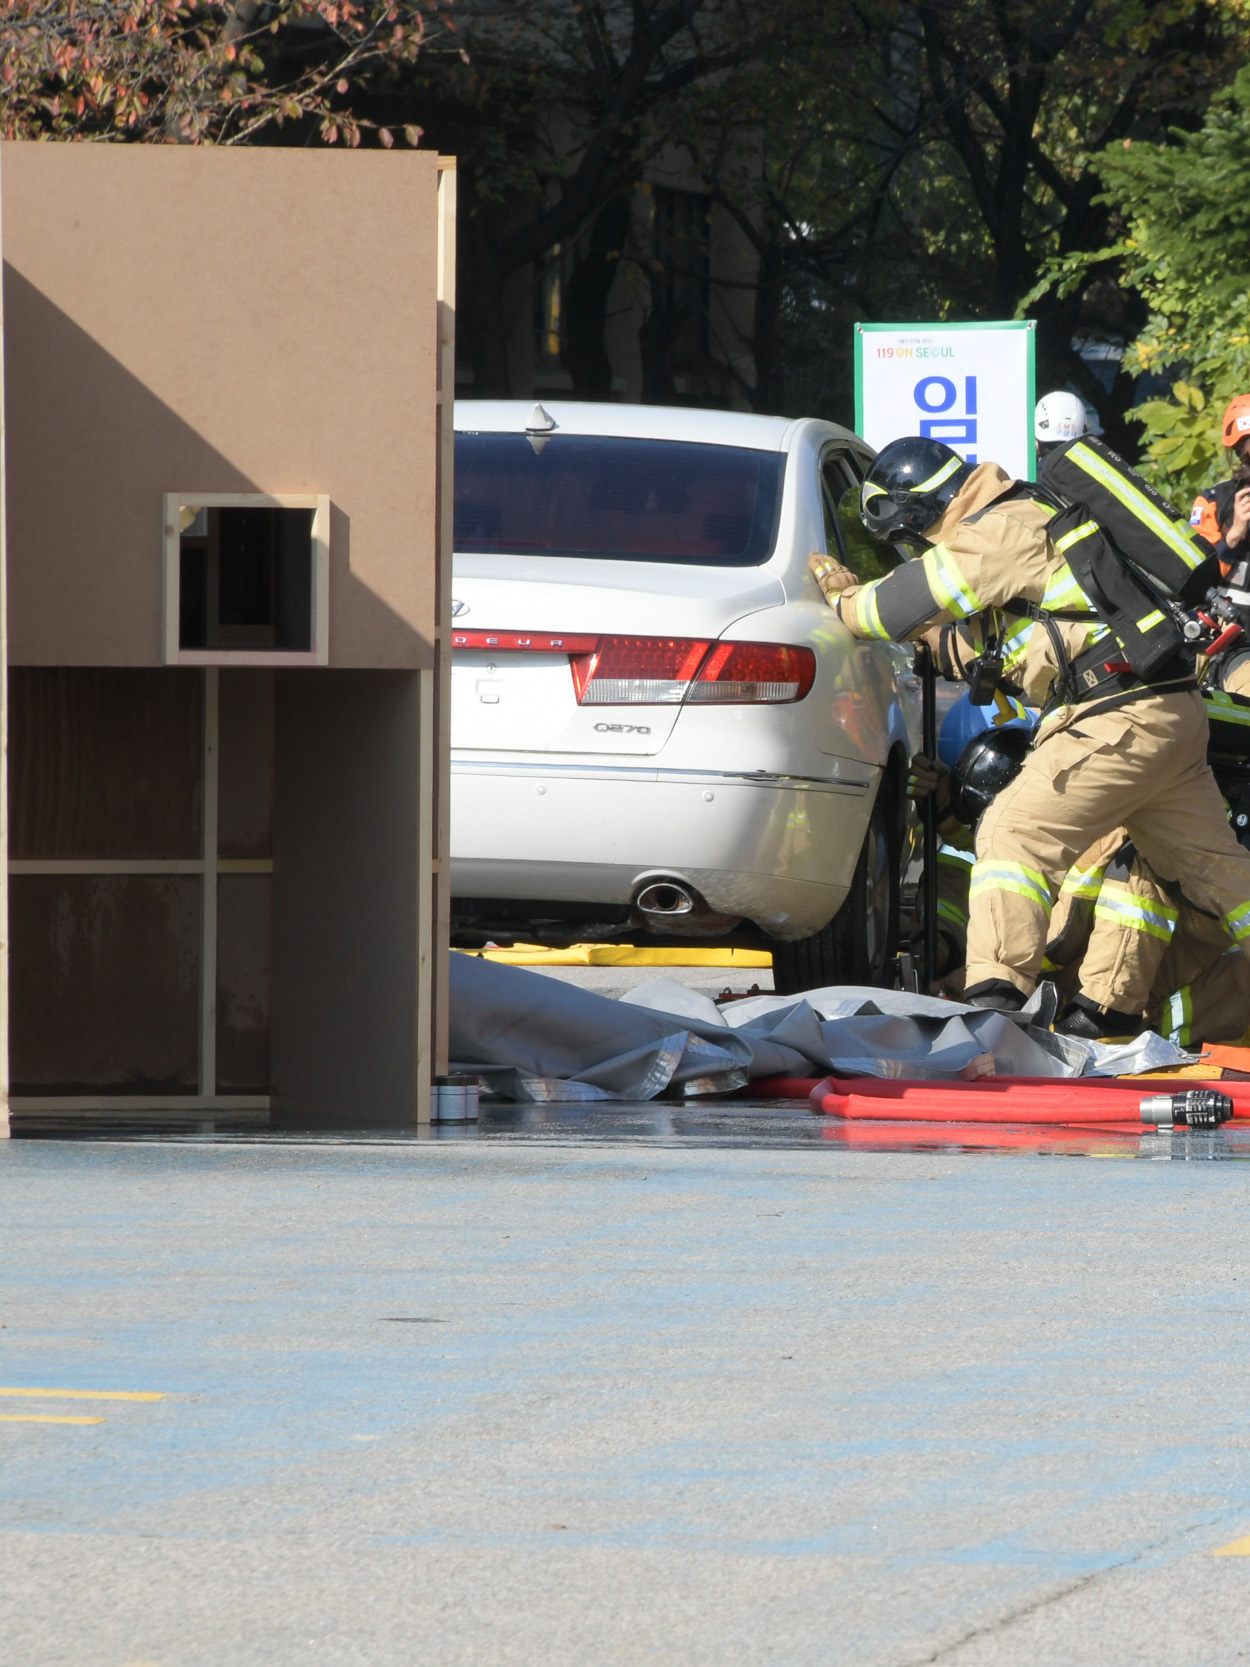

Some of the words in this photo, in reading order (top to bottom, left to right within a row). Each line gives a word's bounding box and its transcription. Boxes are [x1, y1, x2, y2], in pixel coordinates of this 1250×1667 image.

[877, 347, 894, 358] 119
[896, 347, 913, 358] ON
[913, 376, 978, 464] 임
